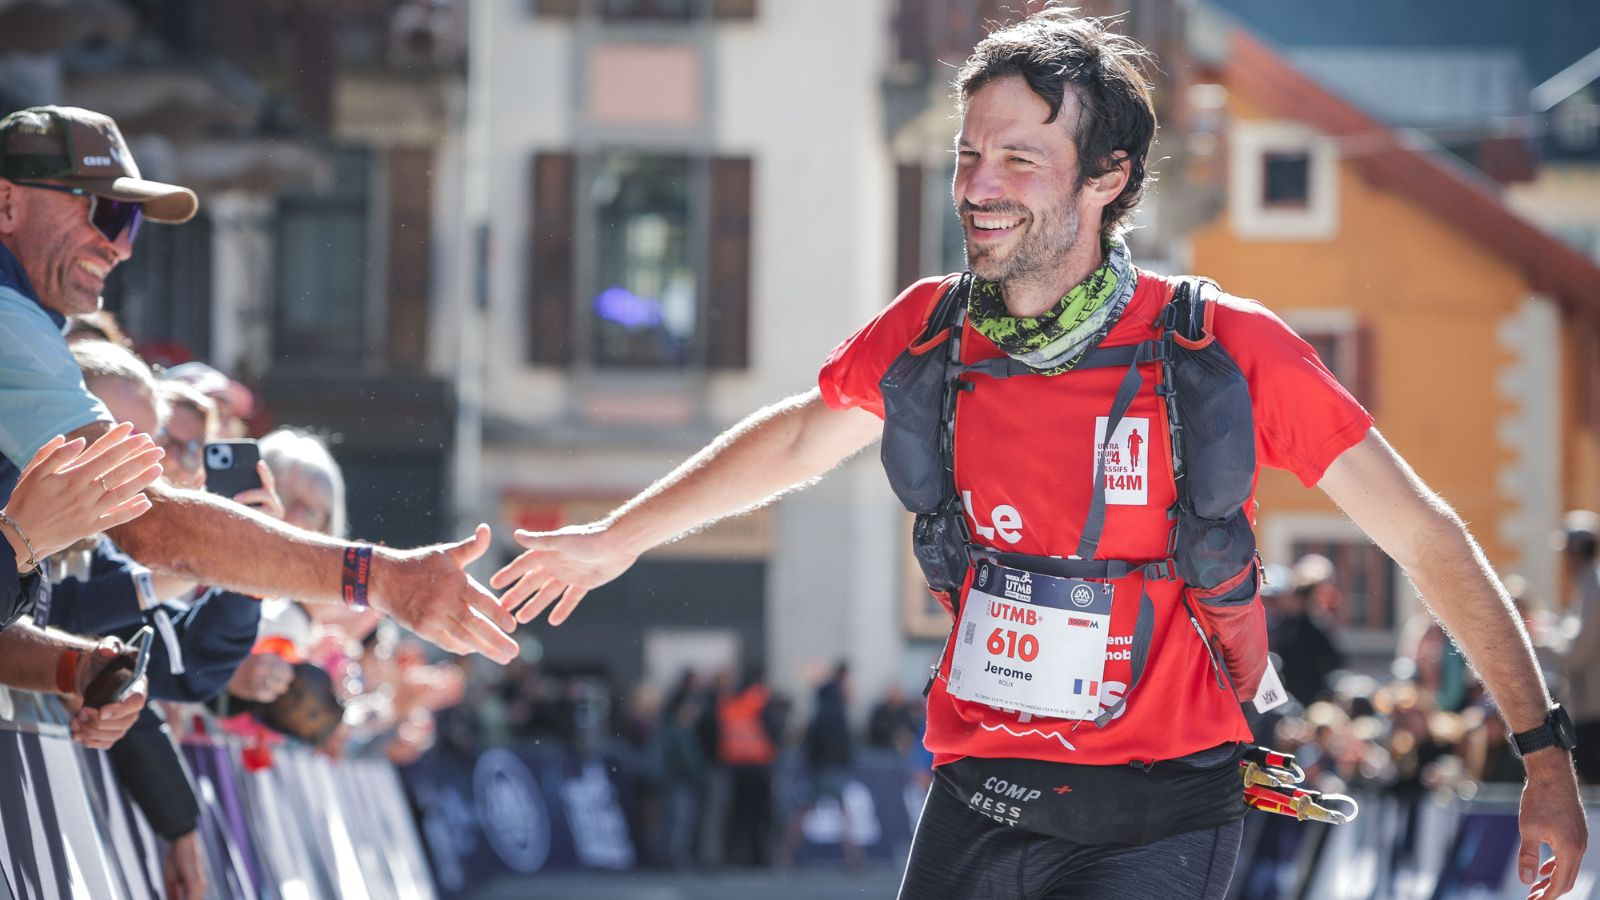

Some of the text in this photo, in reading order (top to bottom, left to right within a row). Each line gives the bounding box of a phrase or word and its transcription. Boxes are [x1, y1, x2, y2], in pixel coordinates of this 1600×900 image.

[1111, 451, 1121, 465] 4
[962, 490, 1023, 544] Le
[1005, 580, 1032, 595] UTMB
[986, 627, 1040, 662] 610
[984, 660, 1033, 681] Jerome
[998, 679, 1014, 687] ROUX
[983, 776, 1042, 802] COMP
[970, 791, 1022, 818] RESS
